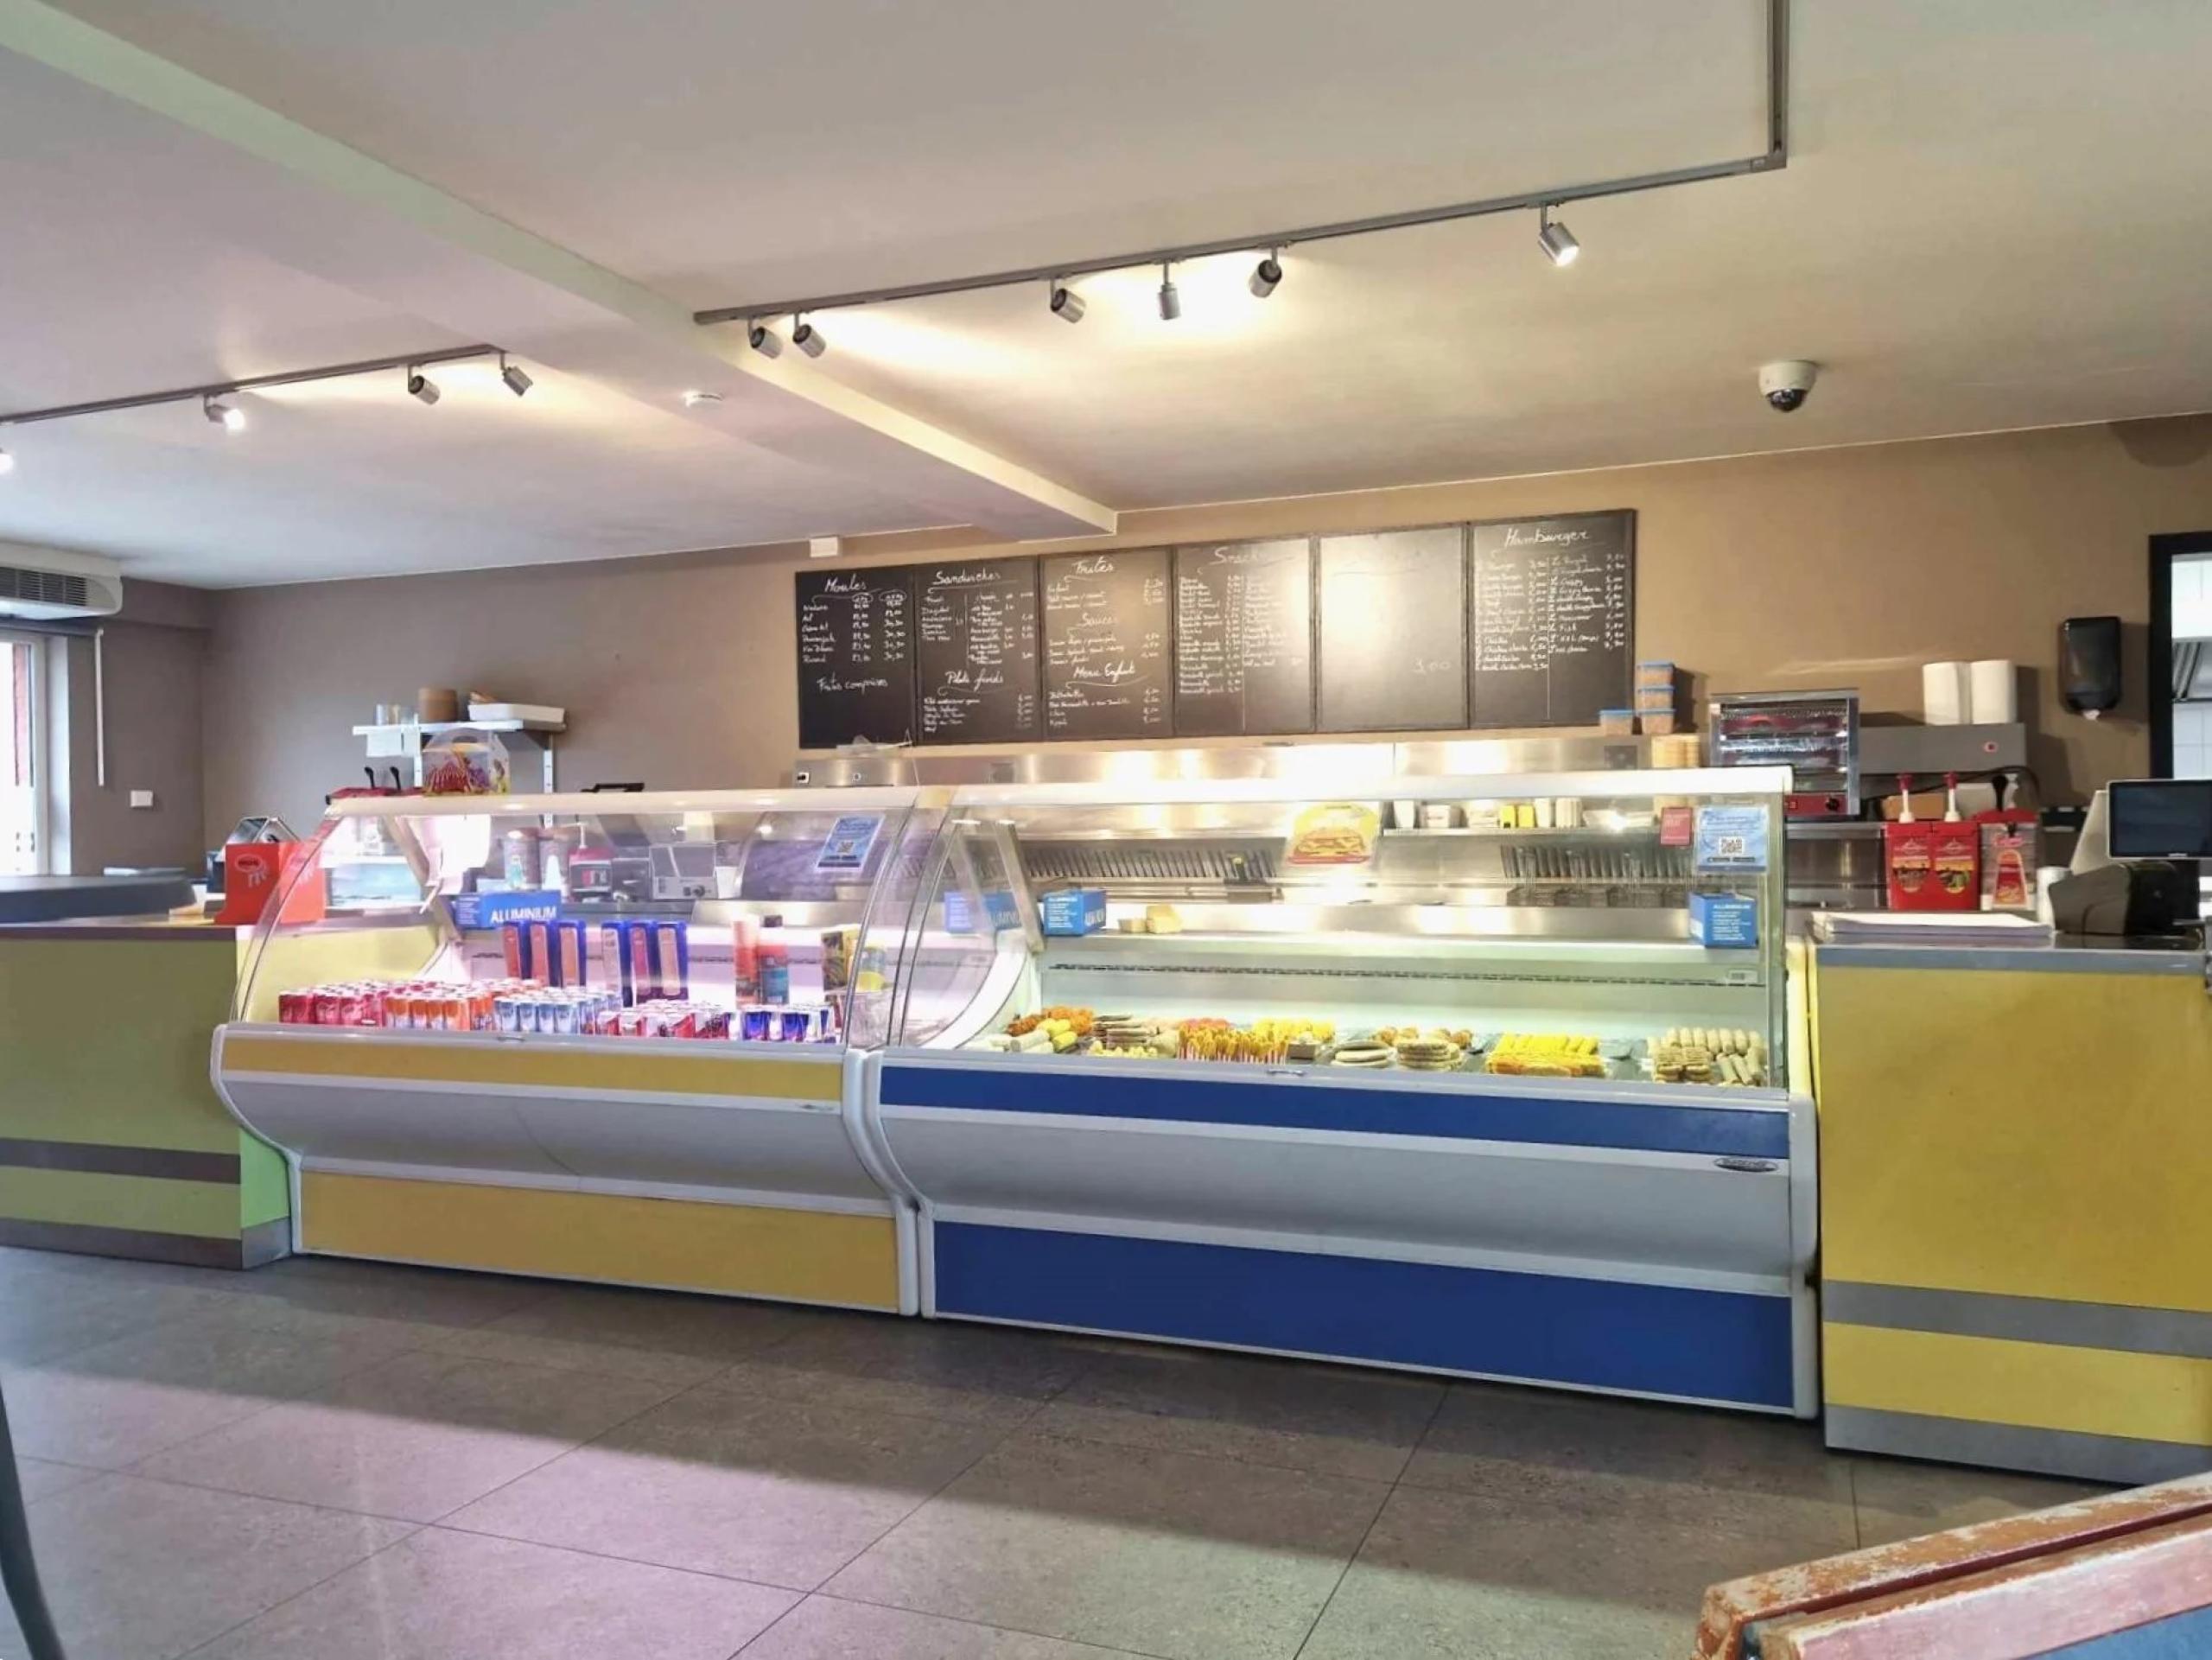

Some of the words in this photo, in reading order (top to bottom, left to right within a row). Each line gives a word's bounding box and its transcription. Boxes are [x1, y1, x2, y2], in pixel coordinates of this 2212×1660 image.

[1504, 527, 1591, 547] Hamburger
[823, 573, 868, 593] Moules
[490, 906, 557, 925] ALUMINIUM
